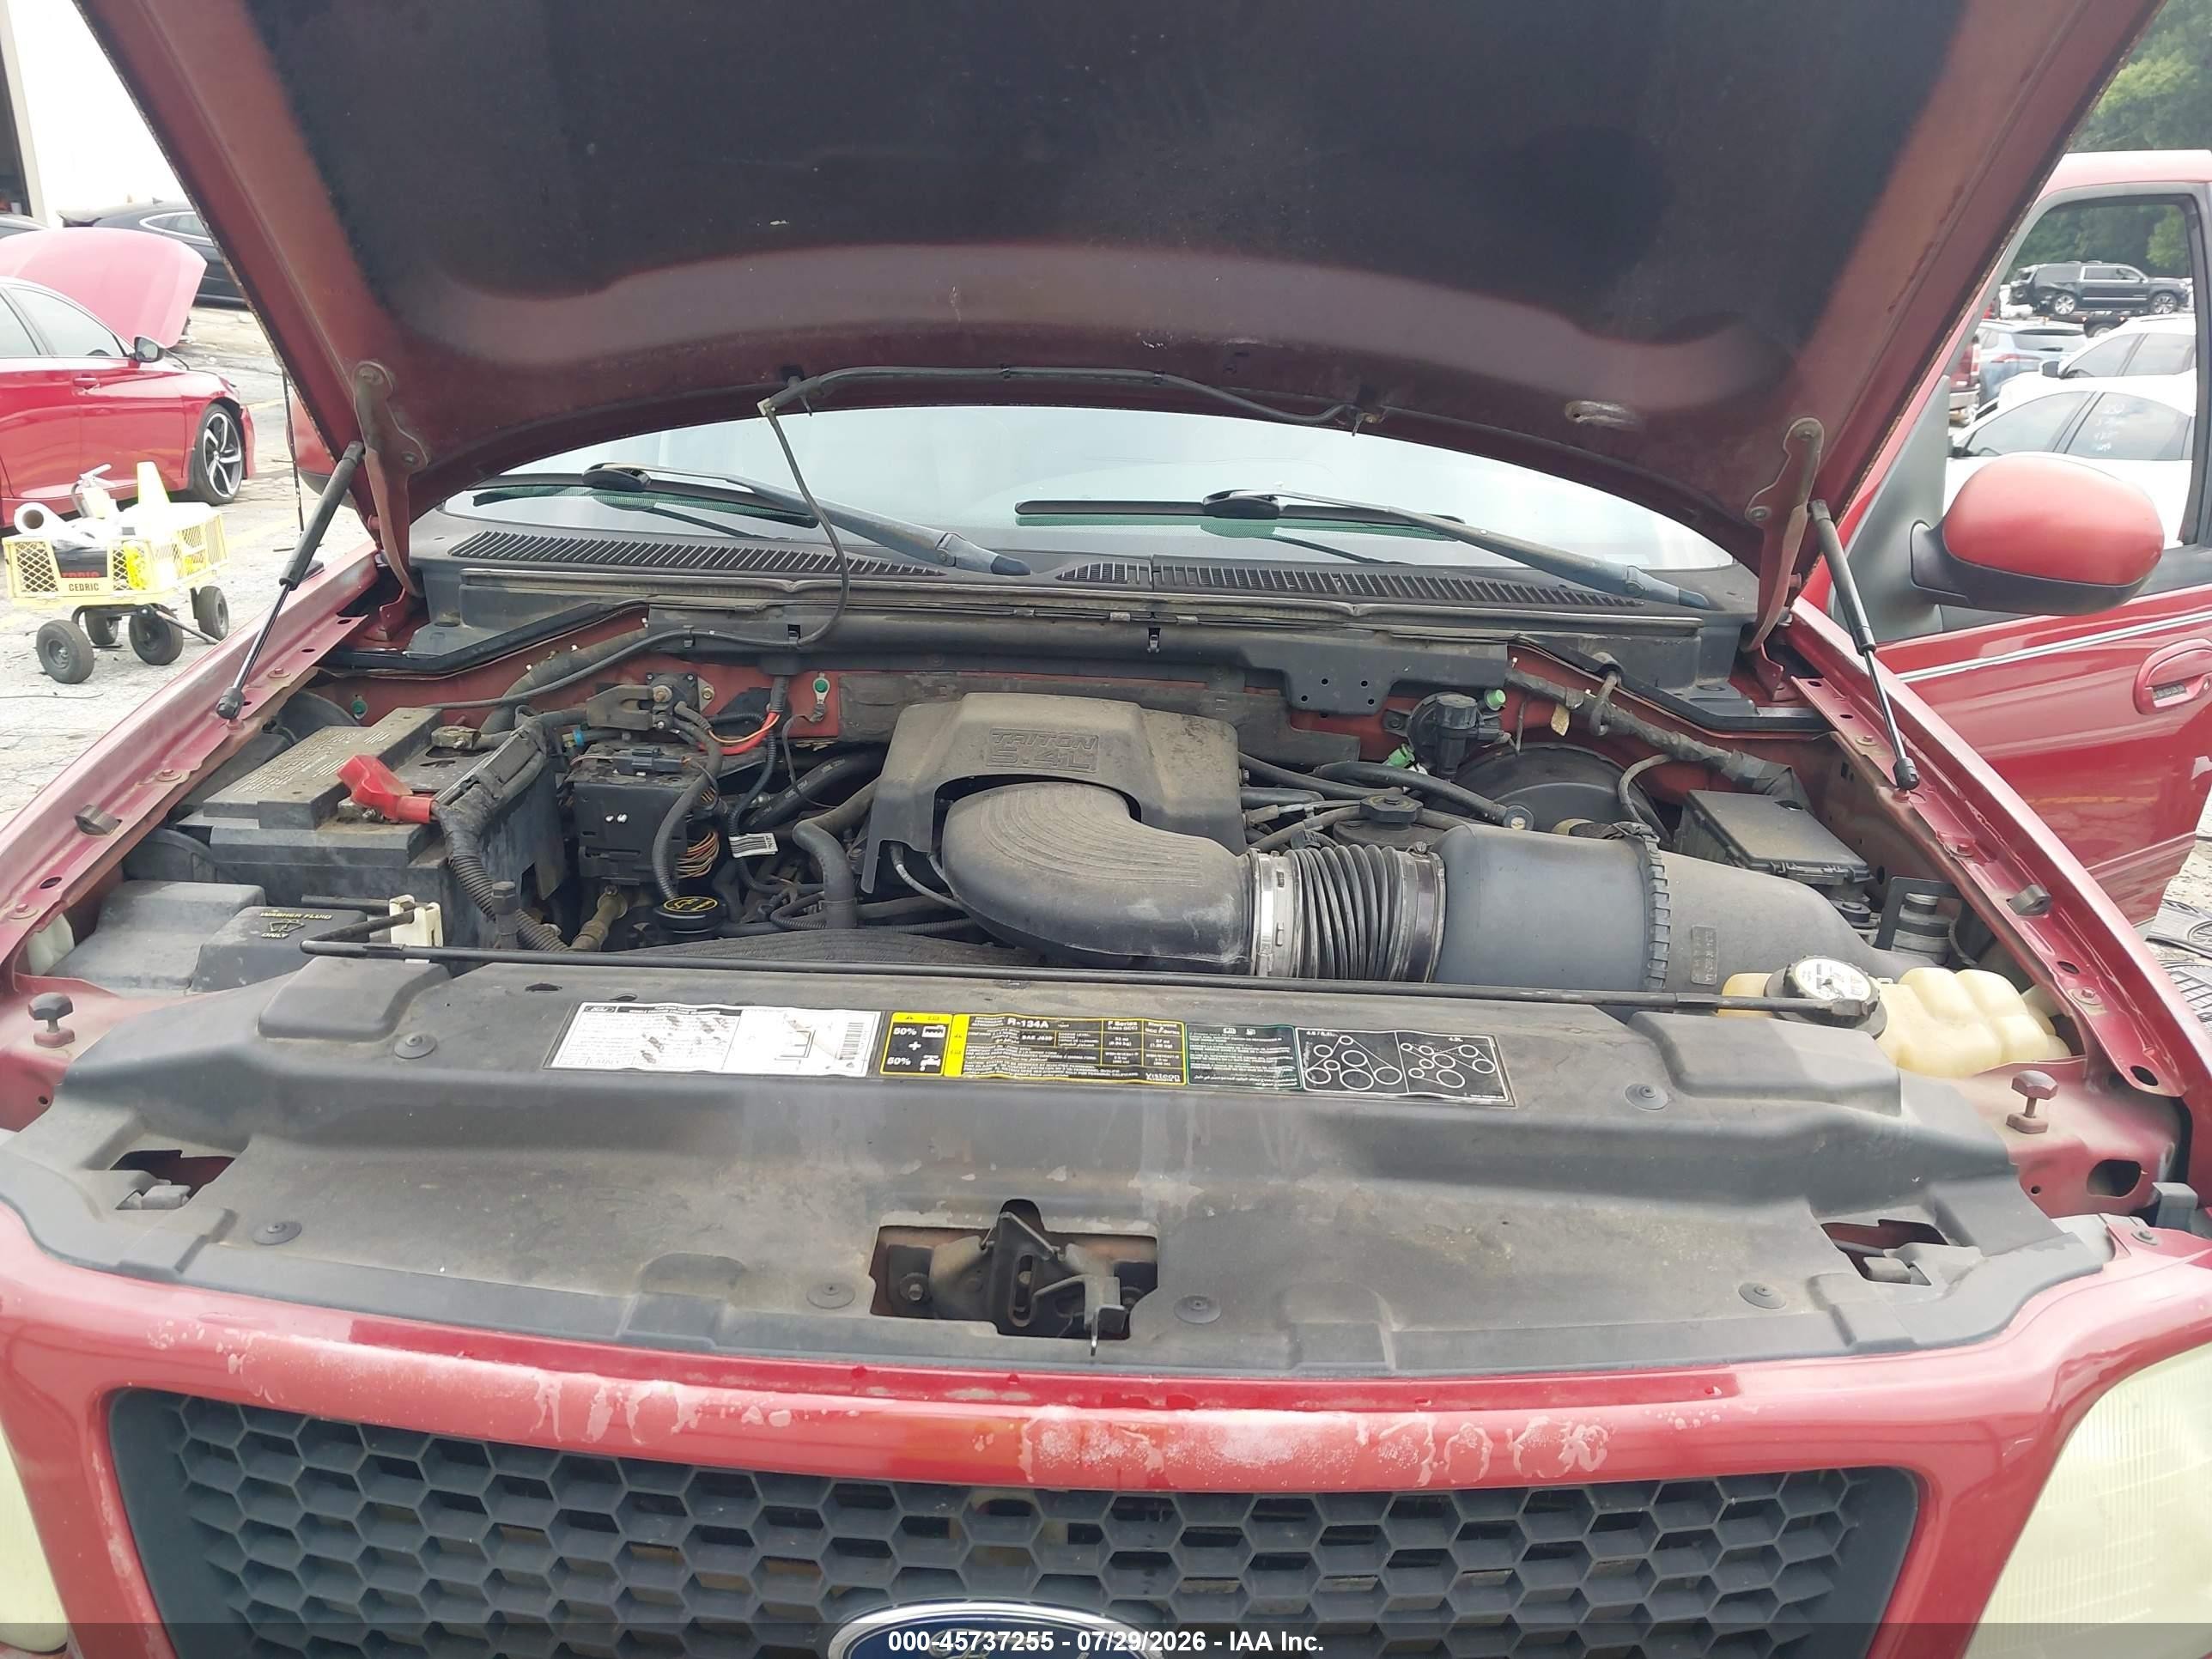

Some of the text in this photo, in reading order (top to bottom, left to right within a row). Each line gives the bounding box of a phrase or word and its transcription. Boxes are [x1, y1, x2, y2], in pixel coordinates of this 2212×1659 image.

[69, 582, 100, 592] CEDRIC
[992, 732, 1098, 750] TRITON
[989, 747, 1092, 768] 5.4L
[1007, 1018, 1048, 1030] R-134A
